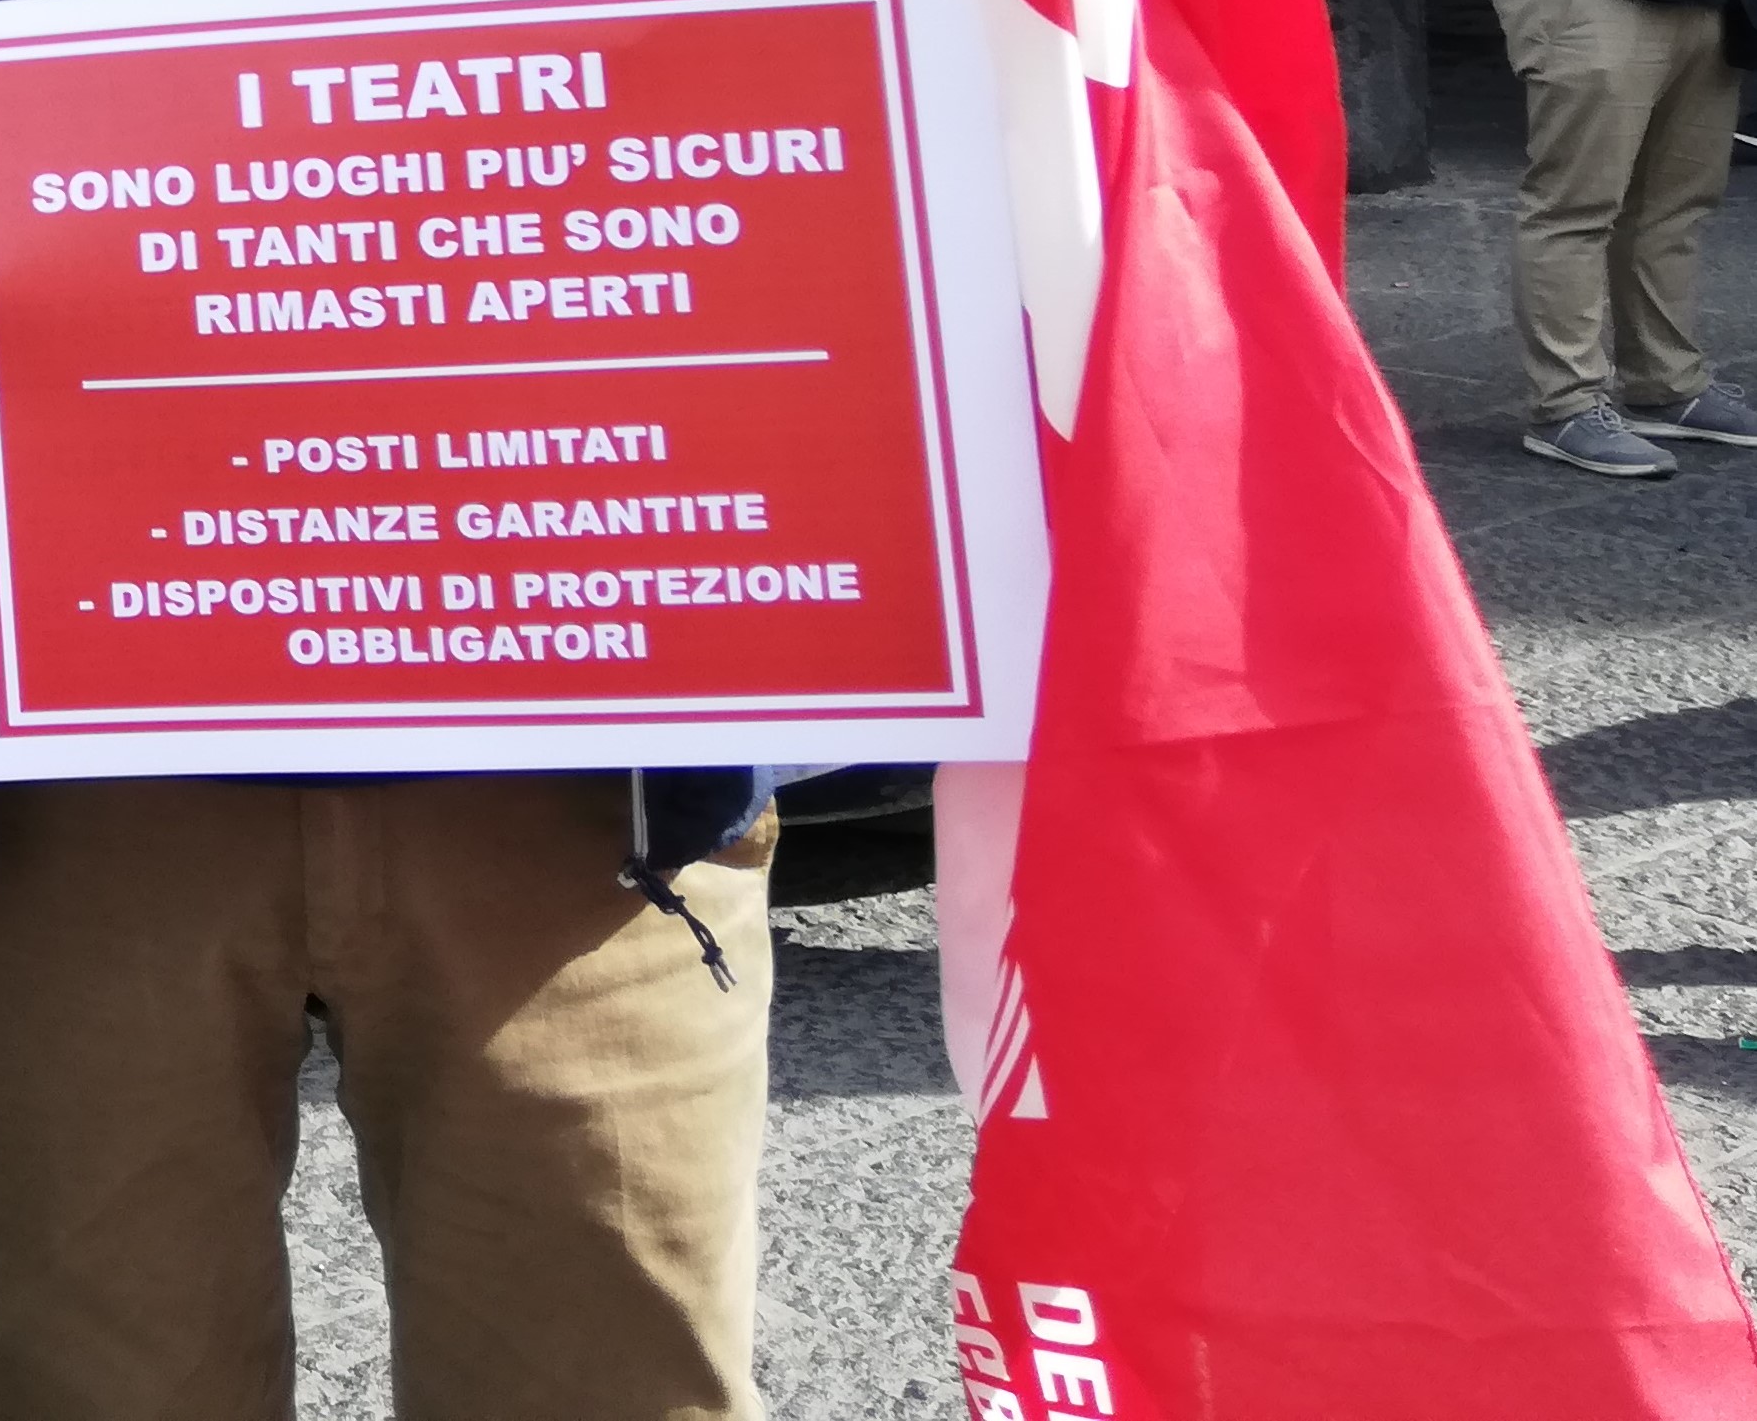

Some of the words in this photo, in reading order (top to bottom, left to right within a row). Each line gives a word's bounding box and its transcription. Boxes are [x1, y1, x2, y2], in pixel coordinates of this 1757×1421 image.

[238, 72, 263, 129] I
[292, 52, 607, 125] TEATRI
[31, 165, 195, 214] SONO
[215, 151, 445, 203] LUOGHI
[466, 143, 586, 190] PIU'
[609, 127, 844, 182] SICURI
[139, 230, 198, 273] DI
[216, 220, 397, 268] TANTI
[418, 213, 544, 259] CHE
[564, 203, 740, 252] SONO
[195, 284, 446, 335] RIMASTI
[467, 272, 691, 323] APERTI
[264, 434, 419, 473] POSTI
[436, 424, 666, 469] LIMITATI
[183, 505, 440, 546] DISTANZE
[456, 493, 768, 540] GARANTITE
[111, 575, 423, 618] DISPOSITIVI
[441, 574, 494, 610] DI
[513, 563, 861, 609] PROTEZIONE
[288, 622, 647, 665] OBBLIGATORI
[1016, 1281, 1114, 1421] DE
